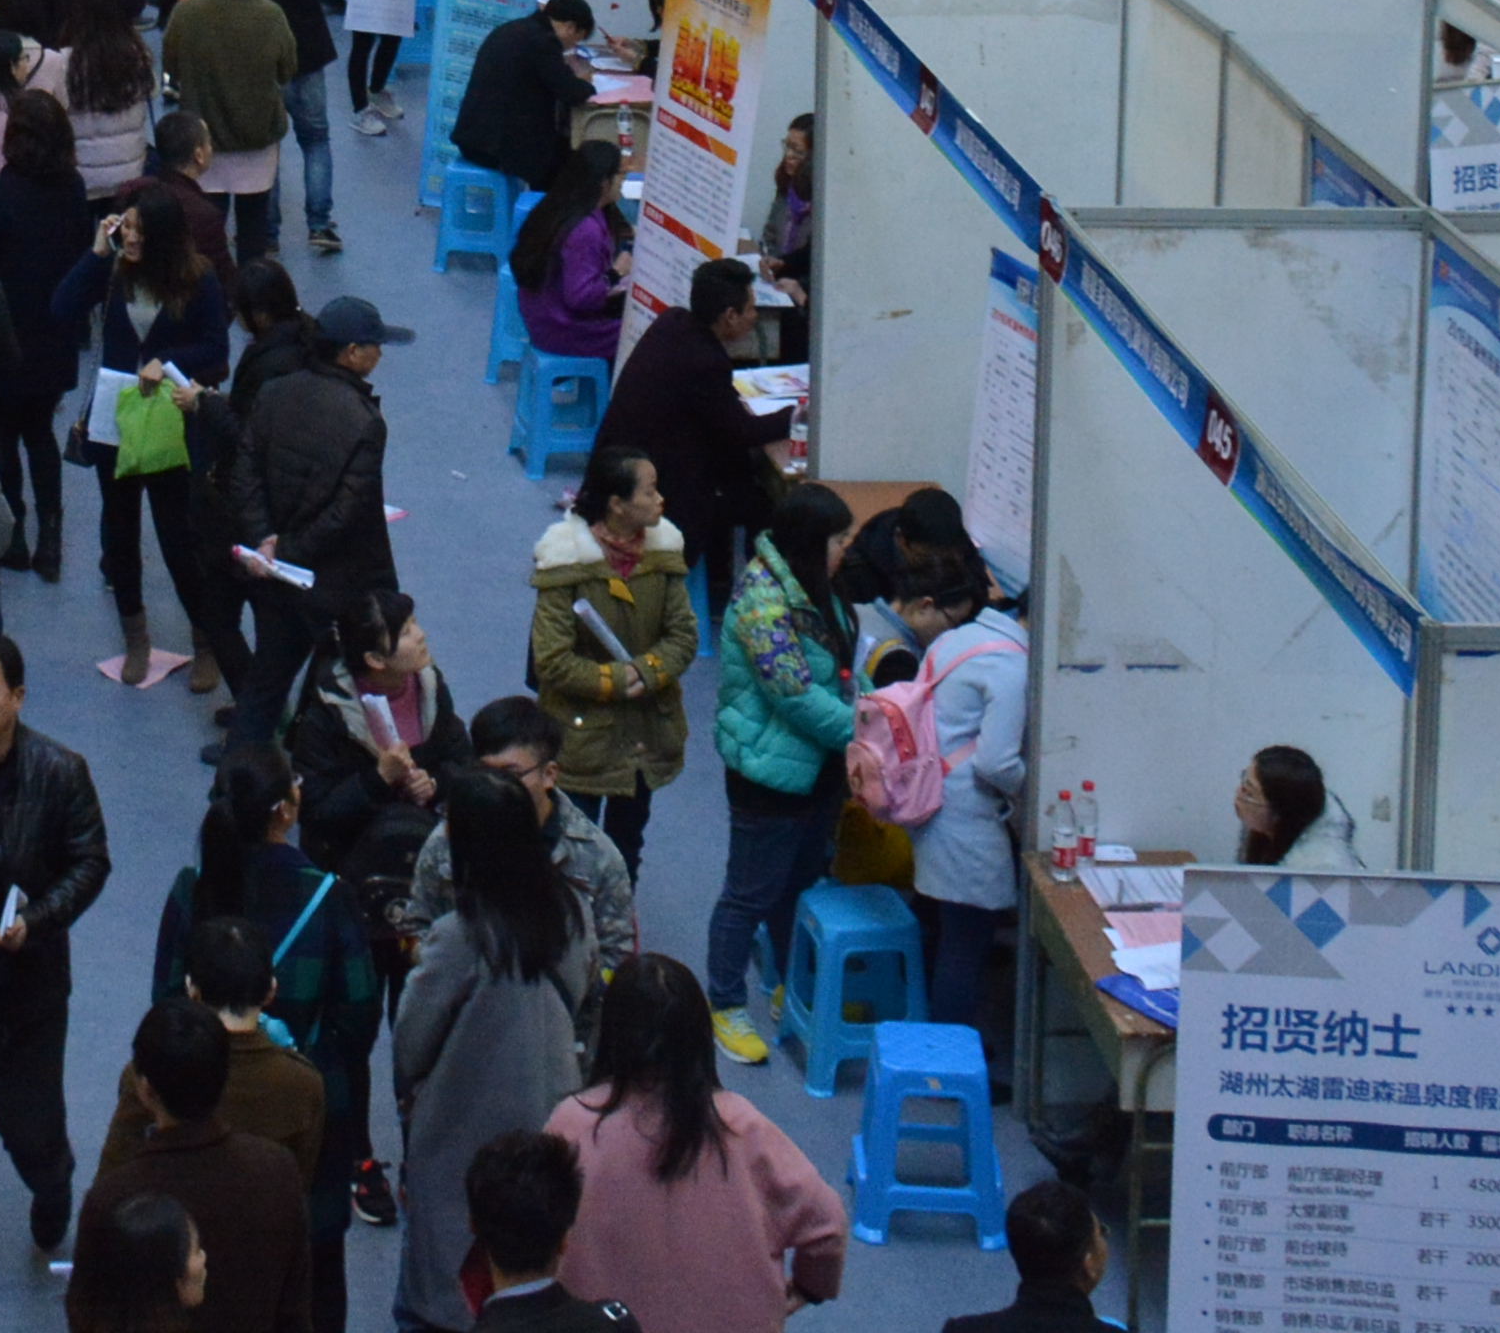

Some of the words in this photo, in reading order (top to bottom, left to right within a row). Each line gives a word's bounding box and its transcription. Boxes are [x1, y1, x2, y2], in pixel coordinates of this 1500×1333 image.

[1205, 409, 1234, 461] 045
[1220, 1003, 1422, 1060] 招贤纳士
[1222, 1119, 1256, 1138] 部门
[1287, 1122, 1353, 1142] 职务名称
[1403, 1130, 1470, 1150] 招聘人数
[1219, 1162, 1269, 1179] 前厅部
[1431, 1176, 1439, 1189] 1
[1218, 1198, 1268, 1217] 前厅部
[1217, 1235, 1267, 1253] 前厅部
